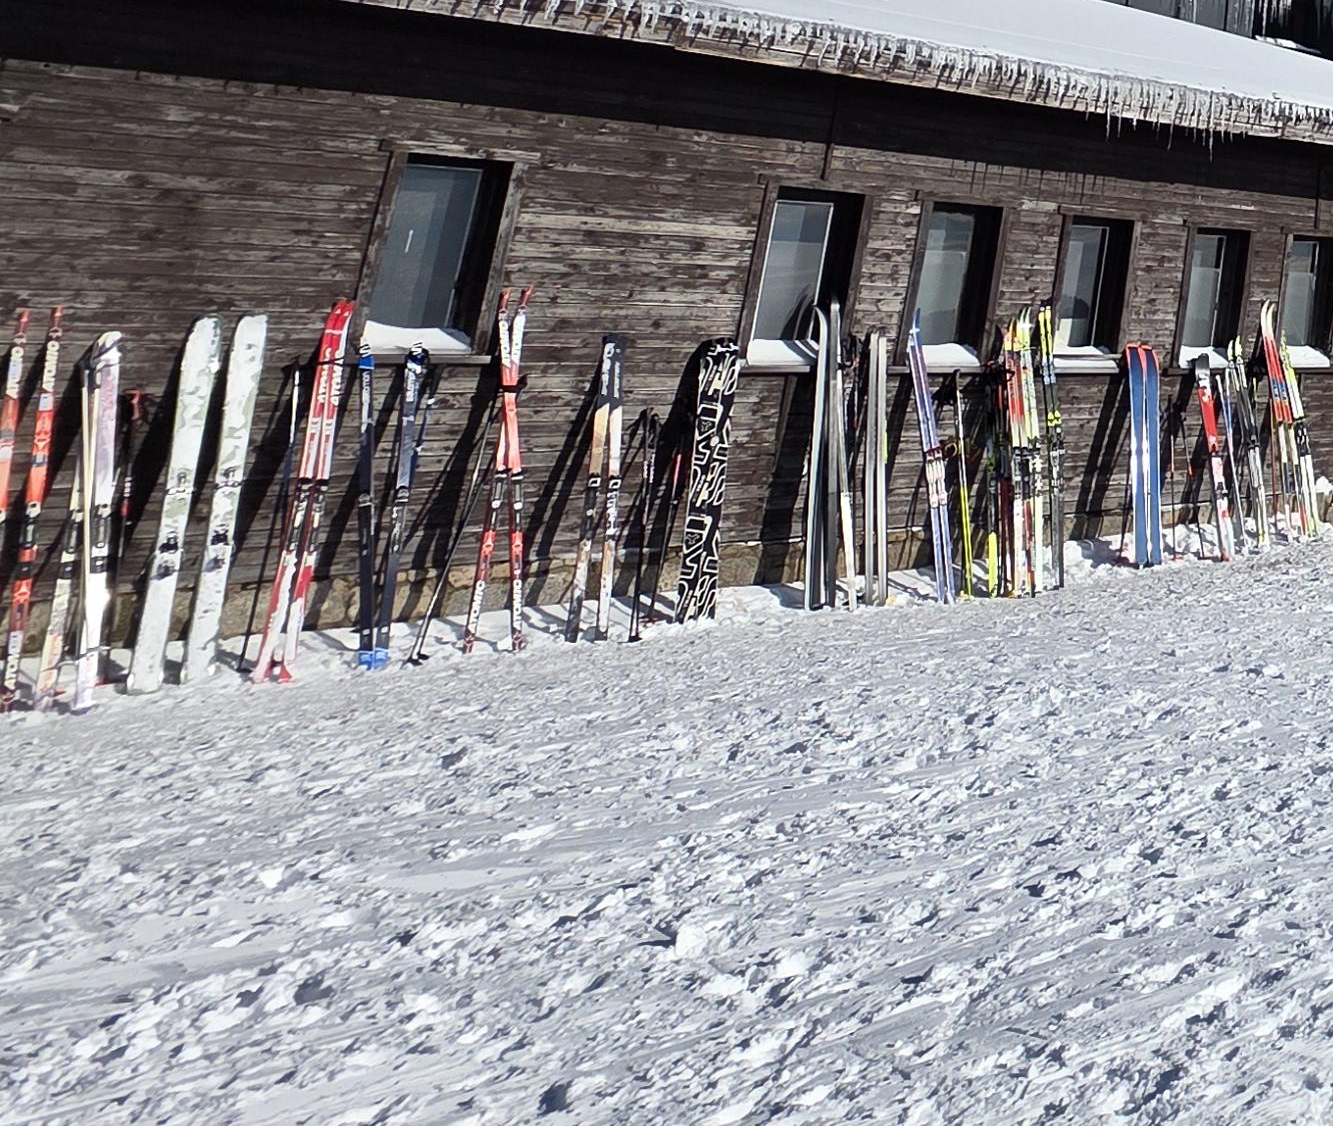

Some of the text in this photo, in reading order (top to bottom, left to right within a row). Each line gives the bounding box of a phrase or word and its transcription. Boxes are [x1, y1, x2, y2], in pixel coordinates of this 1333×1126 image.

[42, 340, 60, 393] ATOMIC
[467, 580, 486, 634] ATOMIC
[513, 579, 523, 631] ATOMIC
